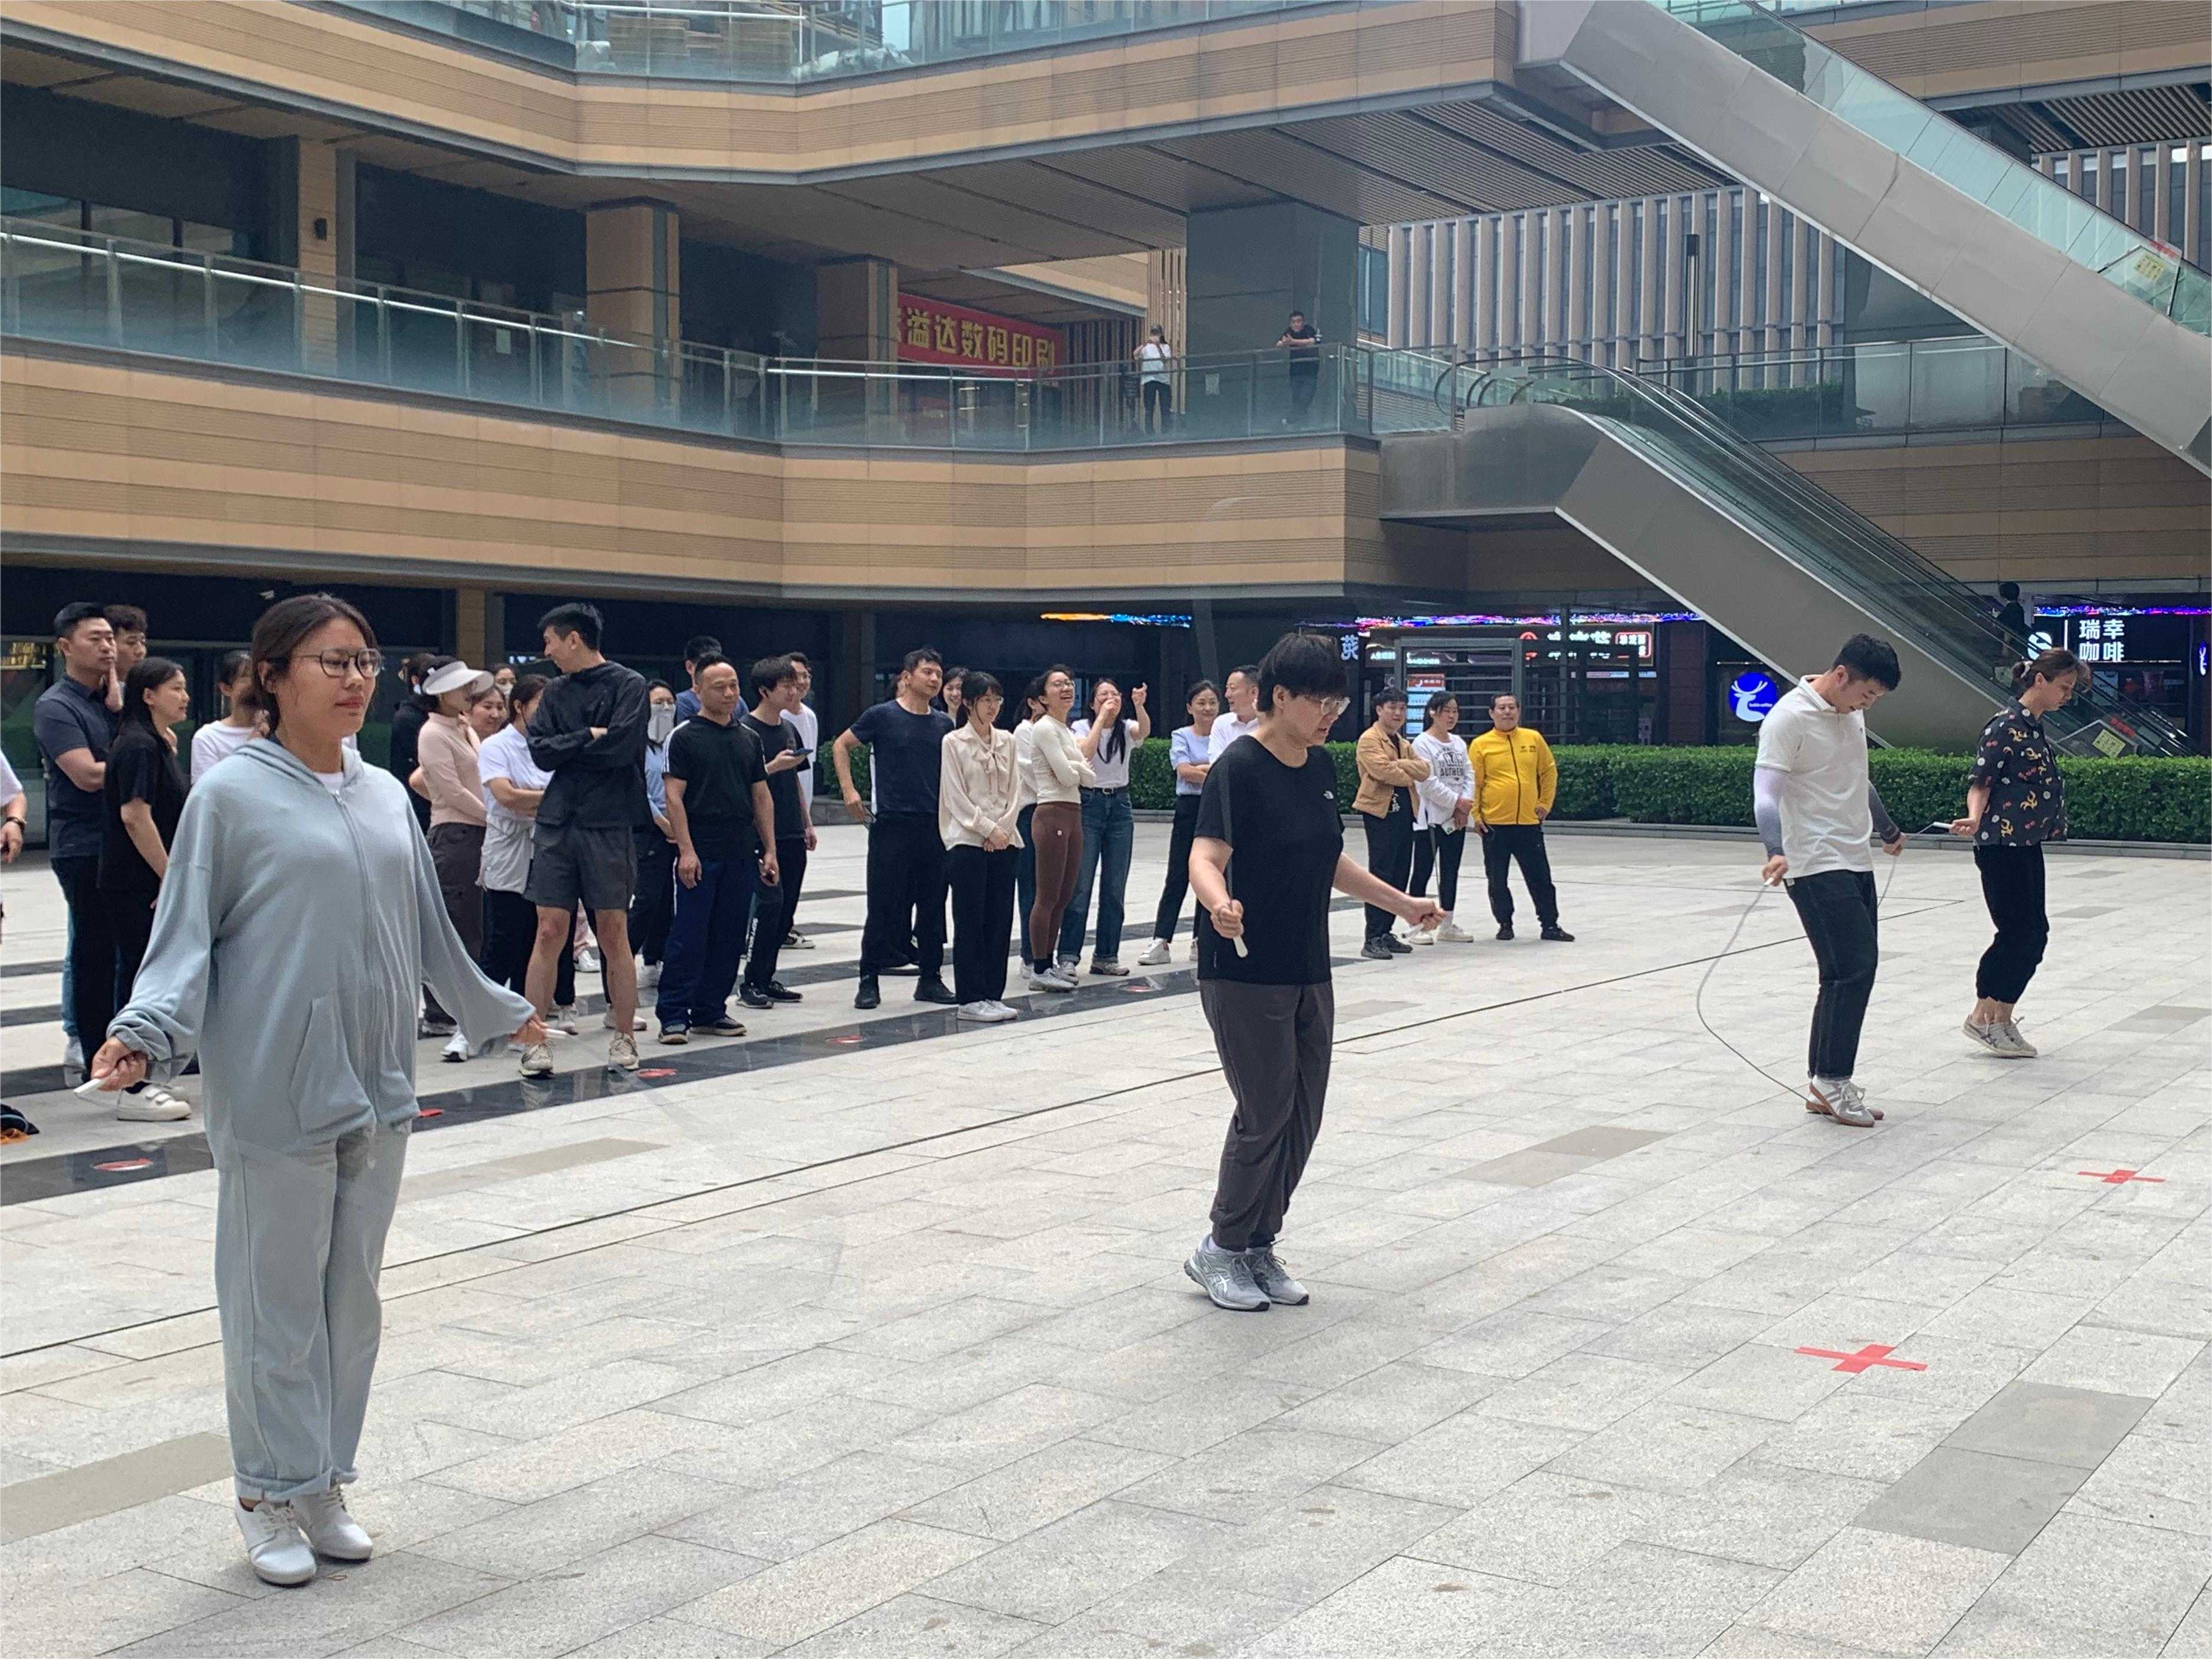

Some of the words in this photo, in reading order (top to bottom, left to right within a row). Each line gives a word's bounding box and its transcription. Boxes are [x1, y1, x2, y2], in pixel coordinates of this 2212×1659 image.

[897, 307, 1055, 368] 溢达数码印刷
[2079, 619, 2125, 640] 瑞幸
[2079, 641, 2125, 662] 咖啡
